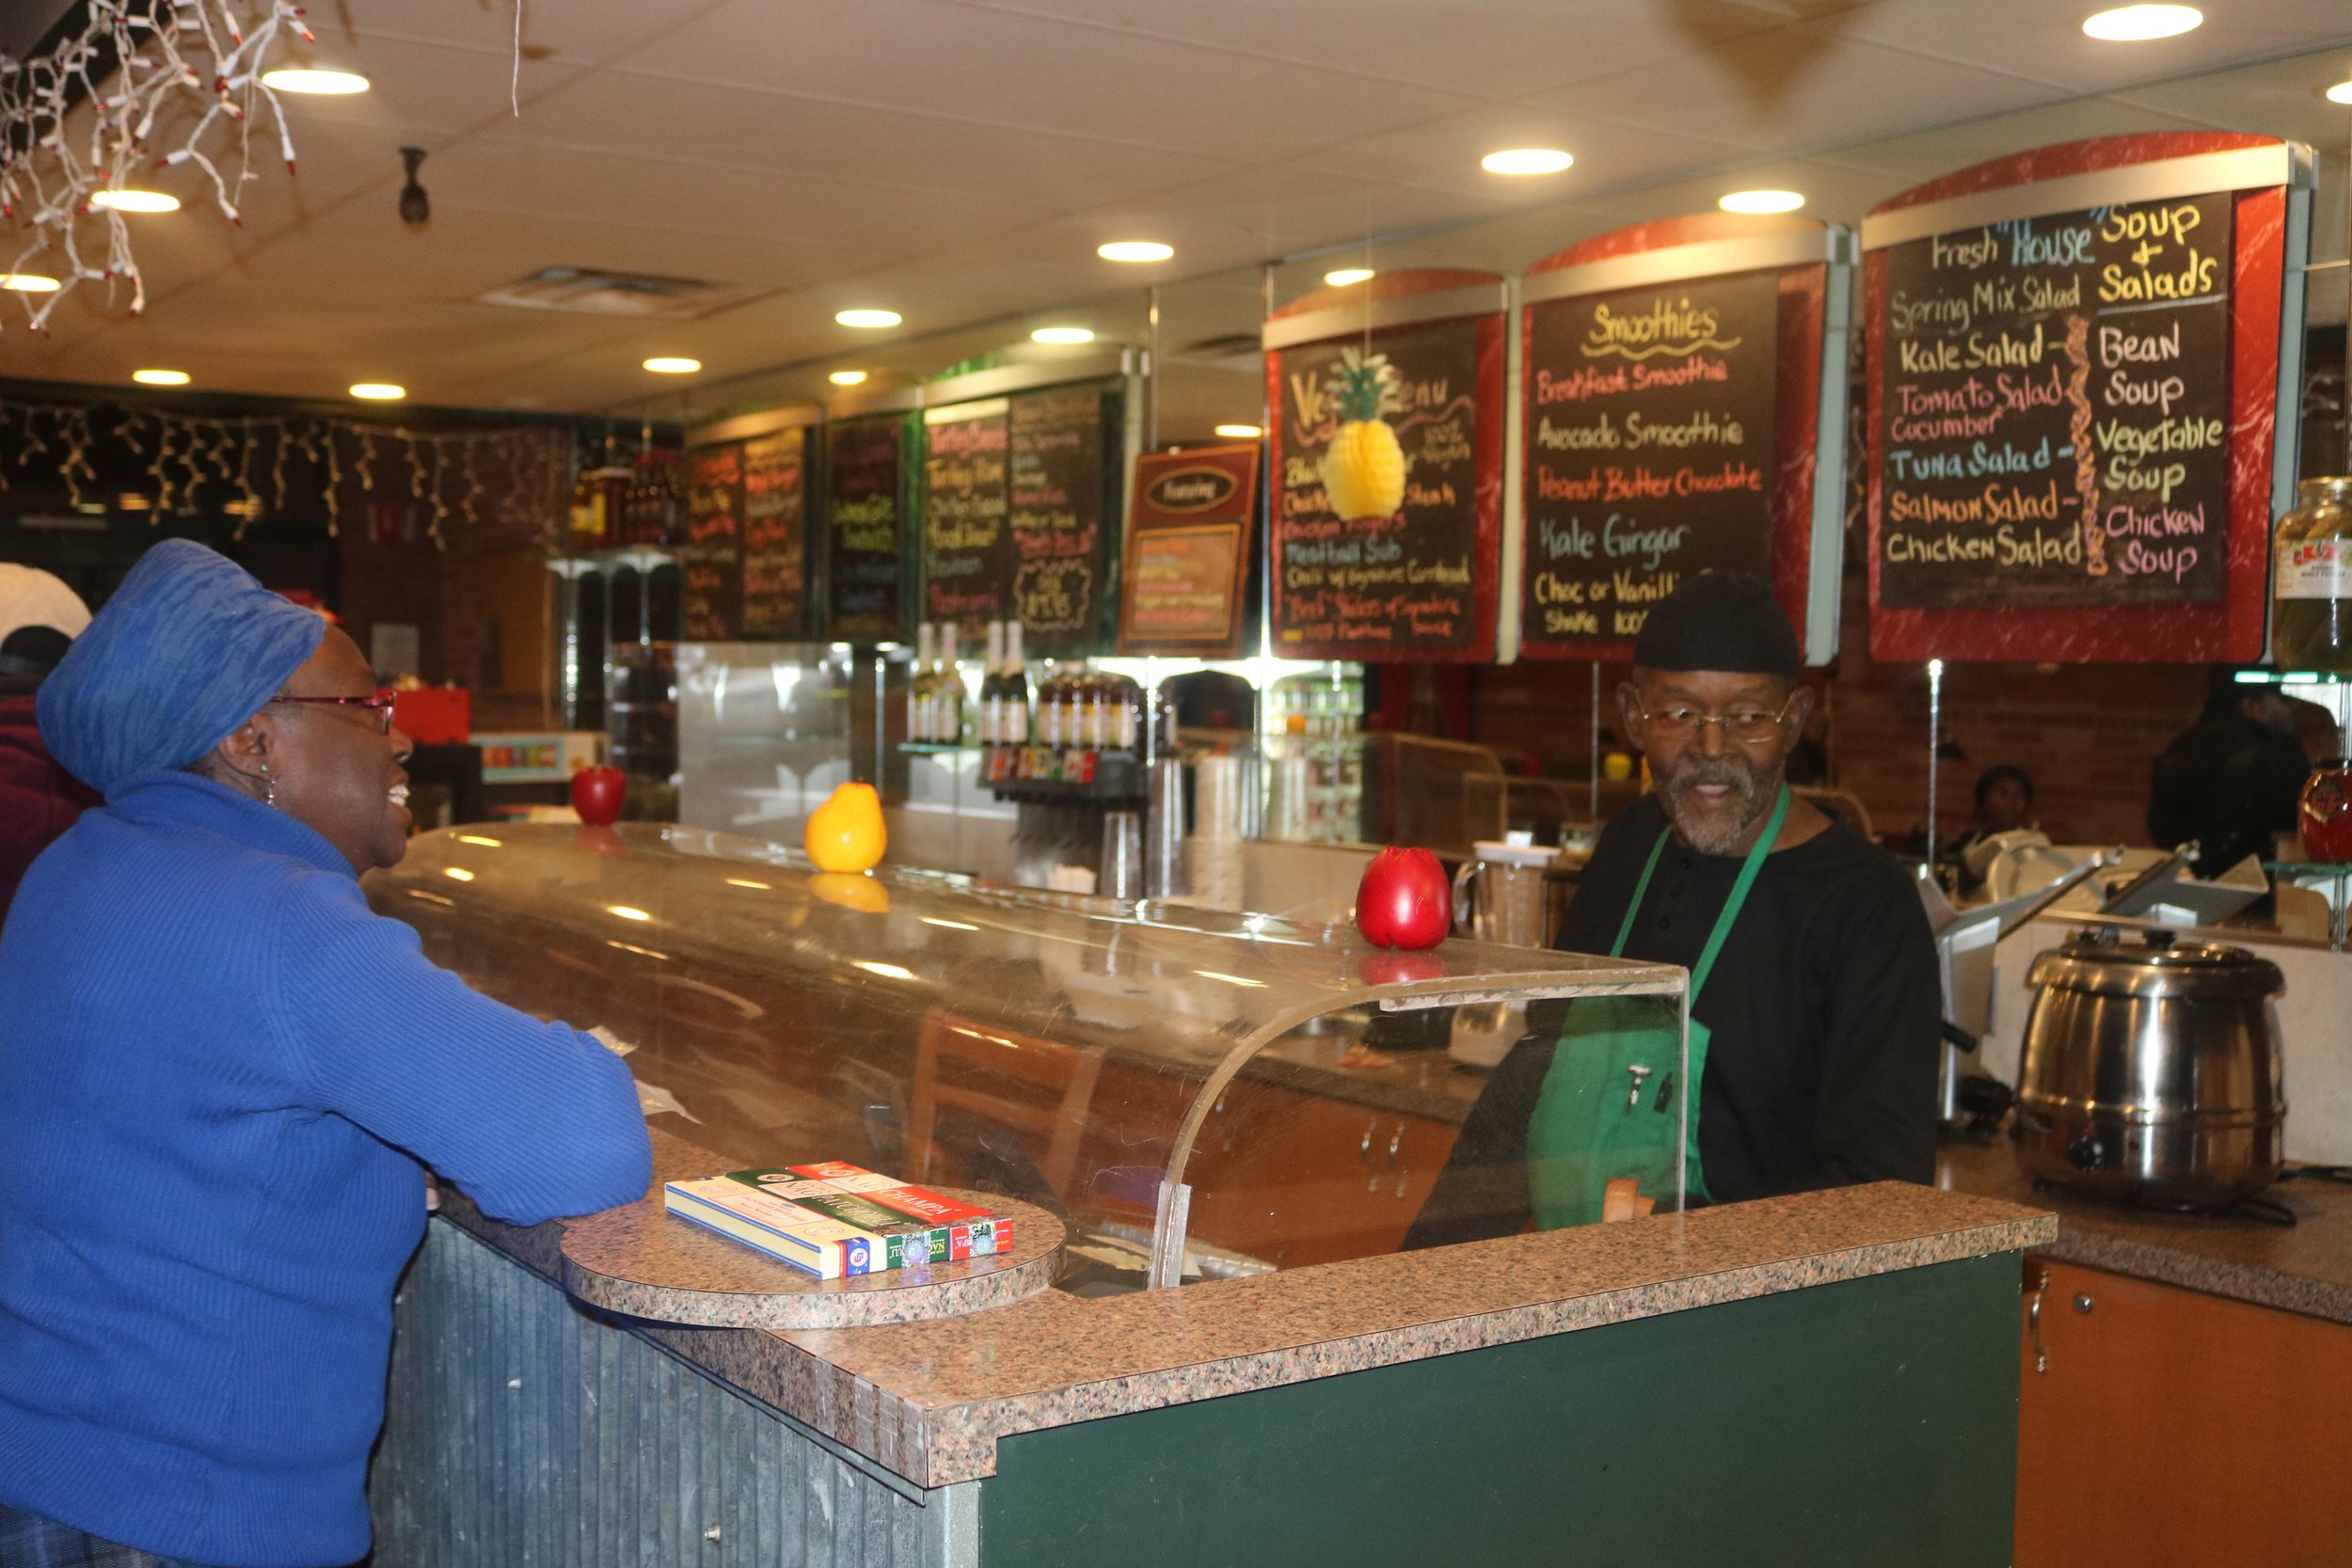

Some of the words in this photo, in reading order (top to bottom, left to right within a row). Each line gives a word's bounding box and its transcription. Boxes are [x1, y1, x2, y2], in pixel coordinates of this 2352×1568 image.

[2101, 204, 2201, 245] Soup
[2098, 249, 2218, 302] Salads
[1588, 296, 1720, 345] Smoothies
[1891, 290, 1971, 336] Spring
[1973, 276, 2017, 315] Mix
[2021, 274, 2081, 309] Salad
[1899, 335, 1961, 374] Kale
[1963, 323, 2044, 370] Salad
[2099, 321, 2181, 370] Bean
[1896, 376, 1995, 417] Tomato
[1995, 364, 2064, 414] Salad
[2104, 371, 2185, 416] Soup
[1536, 412, 1621, 451] Avocado
[1624, 411, 1744, 450] Smoothie
[1890, 411, 1999, 443] Cucumber
[1889, 450, 1965, 481] Tuna
[1966, 436, 2052, 479] Salad
[2104, 455, 2186, 503] Soup
[1536, 464, 1601, 501] Peanut
[1602, 465, 1674, 503] Butter
[1674, 461, 1763, 499] Chocolate
[1889, 490, 1982, 524] Salmon
[1983, 479, 2058, 525] Salad
[1538, 516, 1597, 561] Kale
[2106, 502, 2205, 539] Chicken
[1885, 531, 1995, 563] Chicken
[1995, 519, 2082, 568] Salad
[2118, 539, 2199, 584] Soup
[1534, 570, 1585, 605] Choc
[1588, 580, 1612, 602] or
[1612, 567, 1681, 604] Vanill
[878, 1188, 954, 1215] CHAMPA
